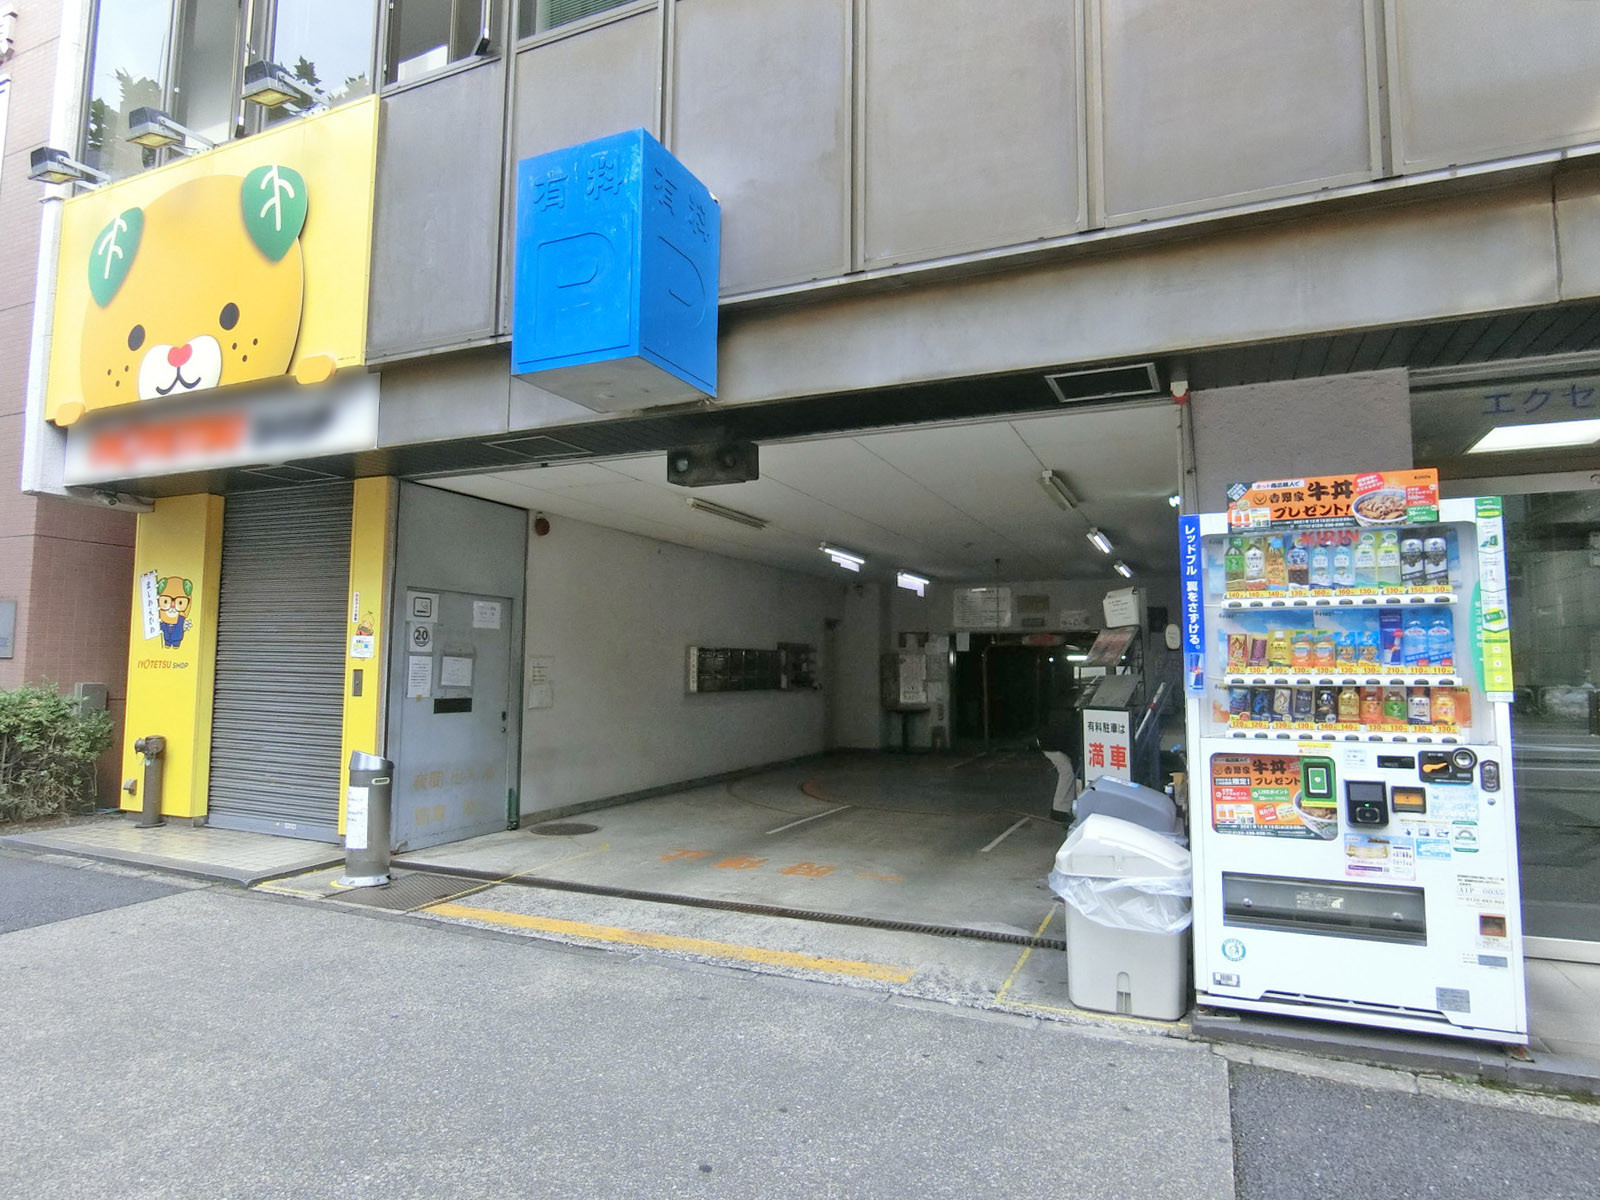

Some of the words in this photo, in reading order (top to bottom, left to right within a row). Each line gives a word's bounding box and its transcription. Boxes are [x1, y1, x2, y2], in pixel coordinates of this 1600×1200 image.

[533, 159, 624, 212] 有料
[536, 232, 616, 342] P
[1482, 384, 1595, 415] エクセ
[1307, 481, 1354, 501] 牛丼
[1185, 524, 1198, 576] レッドブル
[1186, 581, 1201, 650] 翼をさずける。
[415, 629, 428, 640] 20
[137, 658, 172, 669] IYOTETSU
[172, 661, 189, 669] SHOP
[1087, 721, 1126, 734] 有料駐車は
[1088, 742, 1127, 771] 満車
[1252, 759, 1287, 774] 牛丼
